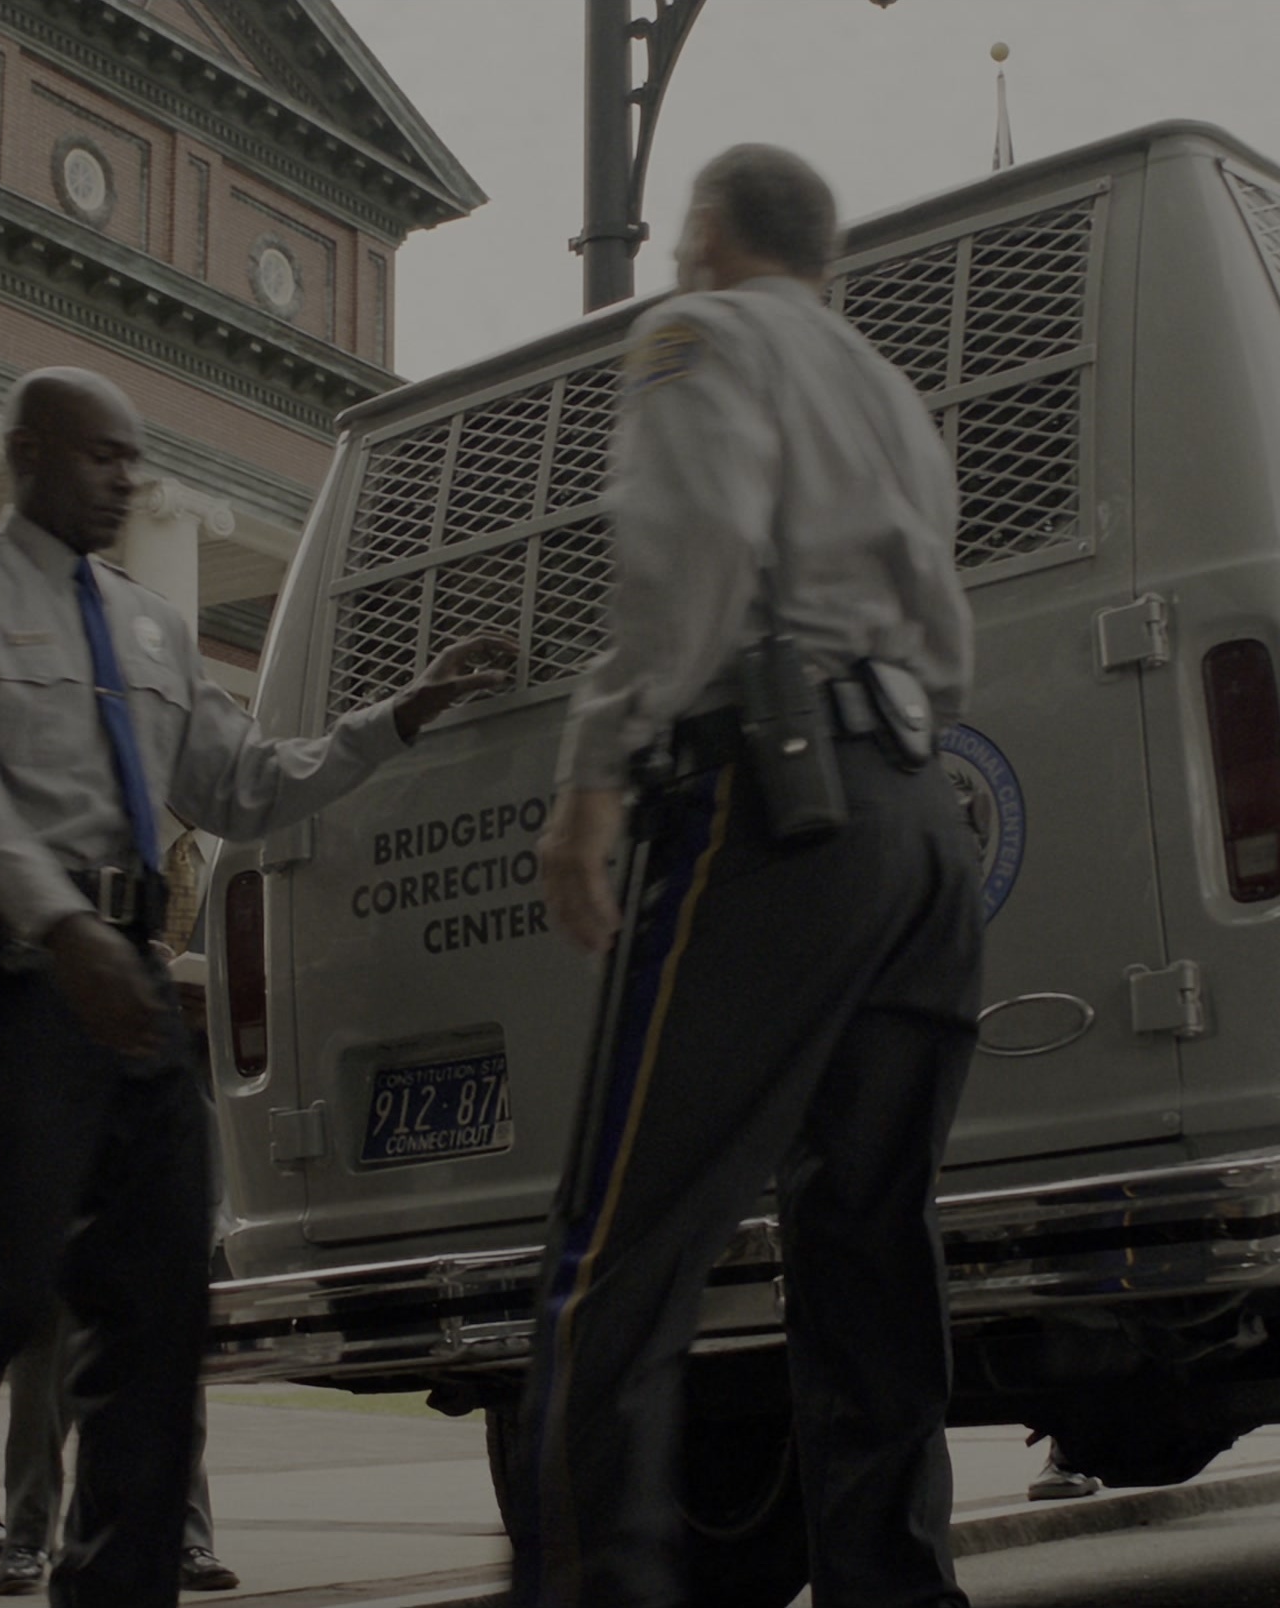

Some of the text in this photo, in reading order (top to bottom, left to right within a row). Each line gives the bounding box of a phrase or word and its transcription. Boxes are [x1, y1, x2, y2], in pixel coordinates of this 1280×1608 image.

[374, 795, 553, 865] BRIDGEPO
[351, 850, 542, 918] CORRECTIO
[423, 901, 549, 954] CENTER
[378, 1058, 505, 1088] CONSTITUTION STA
[385, 1124, 491, 1155] CONNECTICUT
